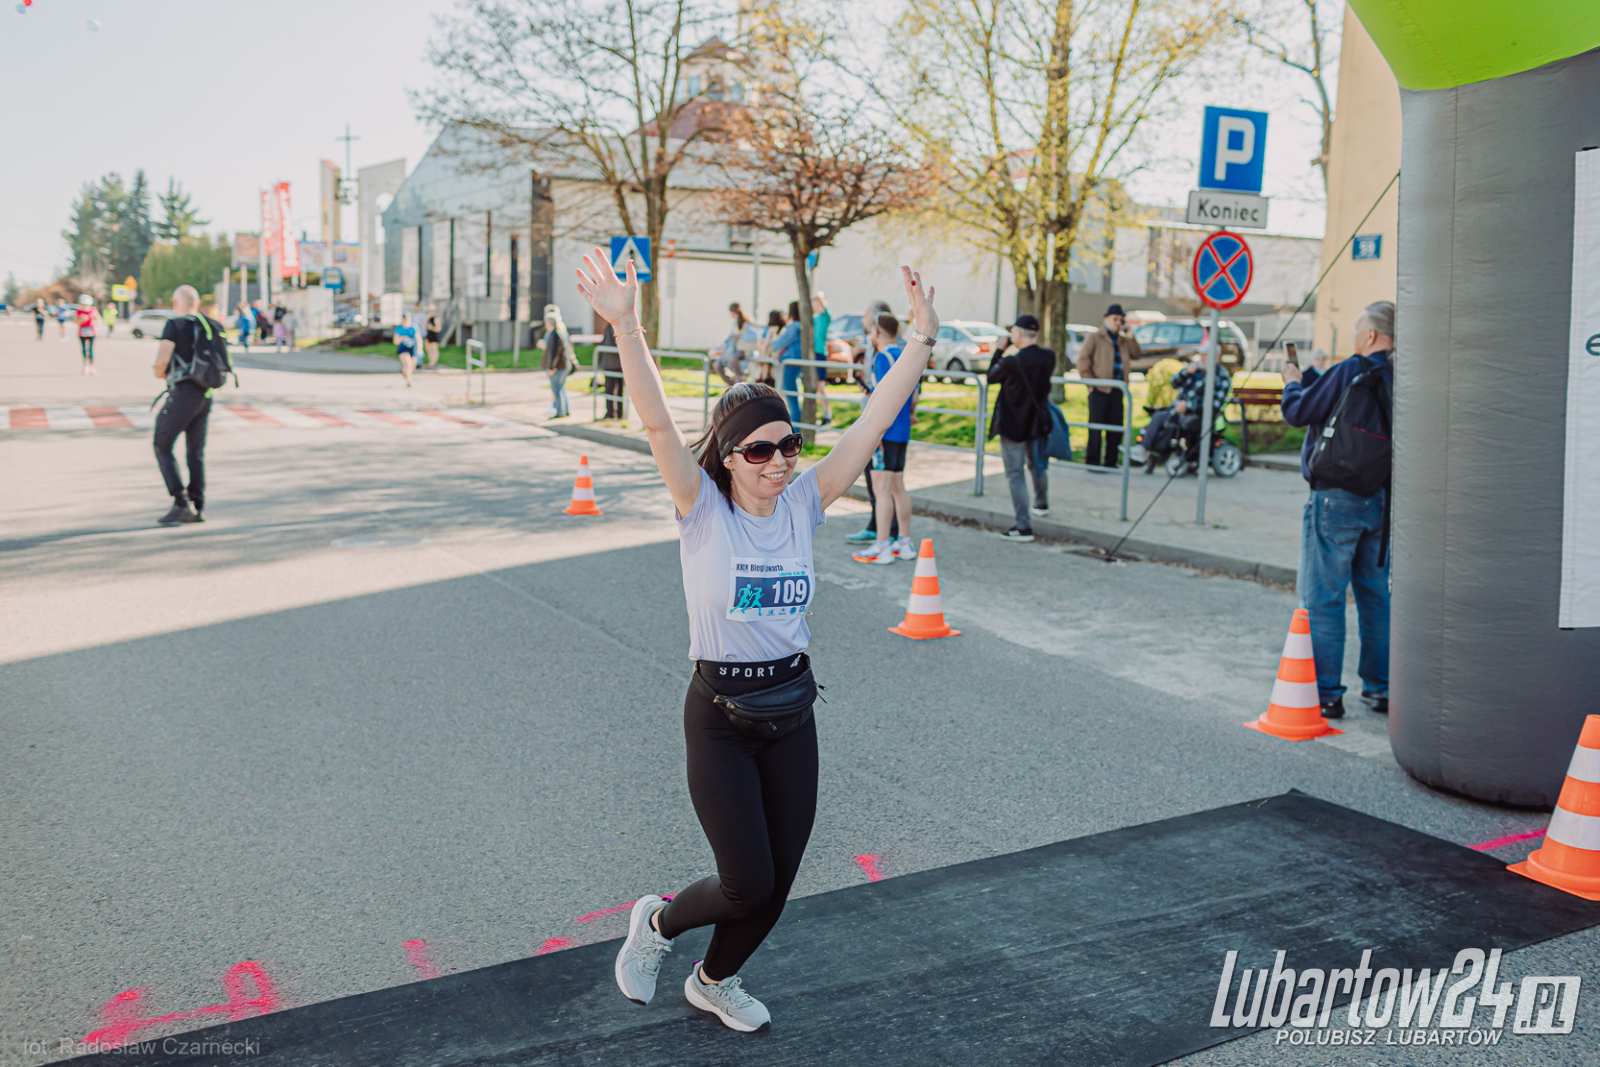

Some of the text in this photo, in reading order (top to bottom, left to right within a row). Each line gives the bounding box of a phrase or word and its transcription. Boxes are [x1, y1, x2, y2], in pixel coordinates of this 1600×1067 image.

[1214, 115, 1256, 181] P
[1197, 198, 1259, 222] Koniec
[772, 579, 807, 604] 109
[719, 665, 775, 677] SPORT
